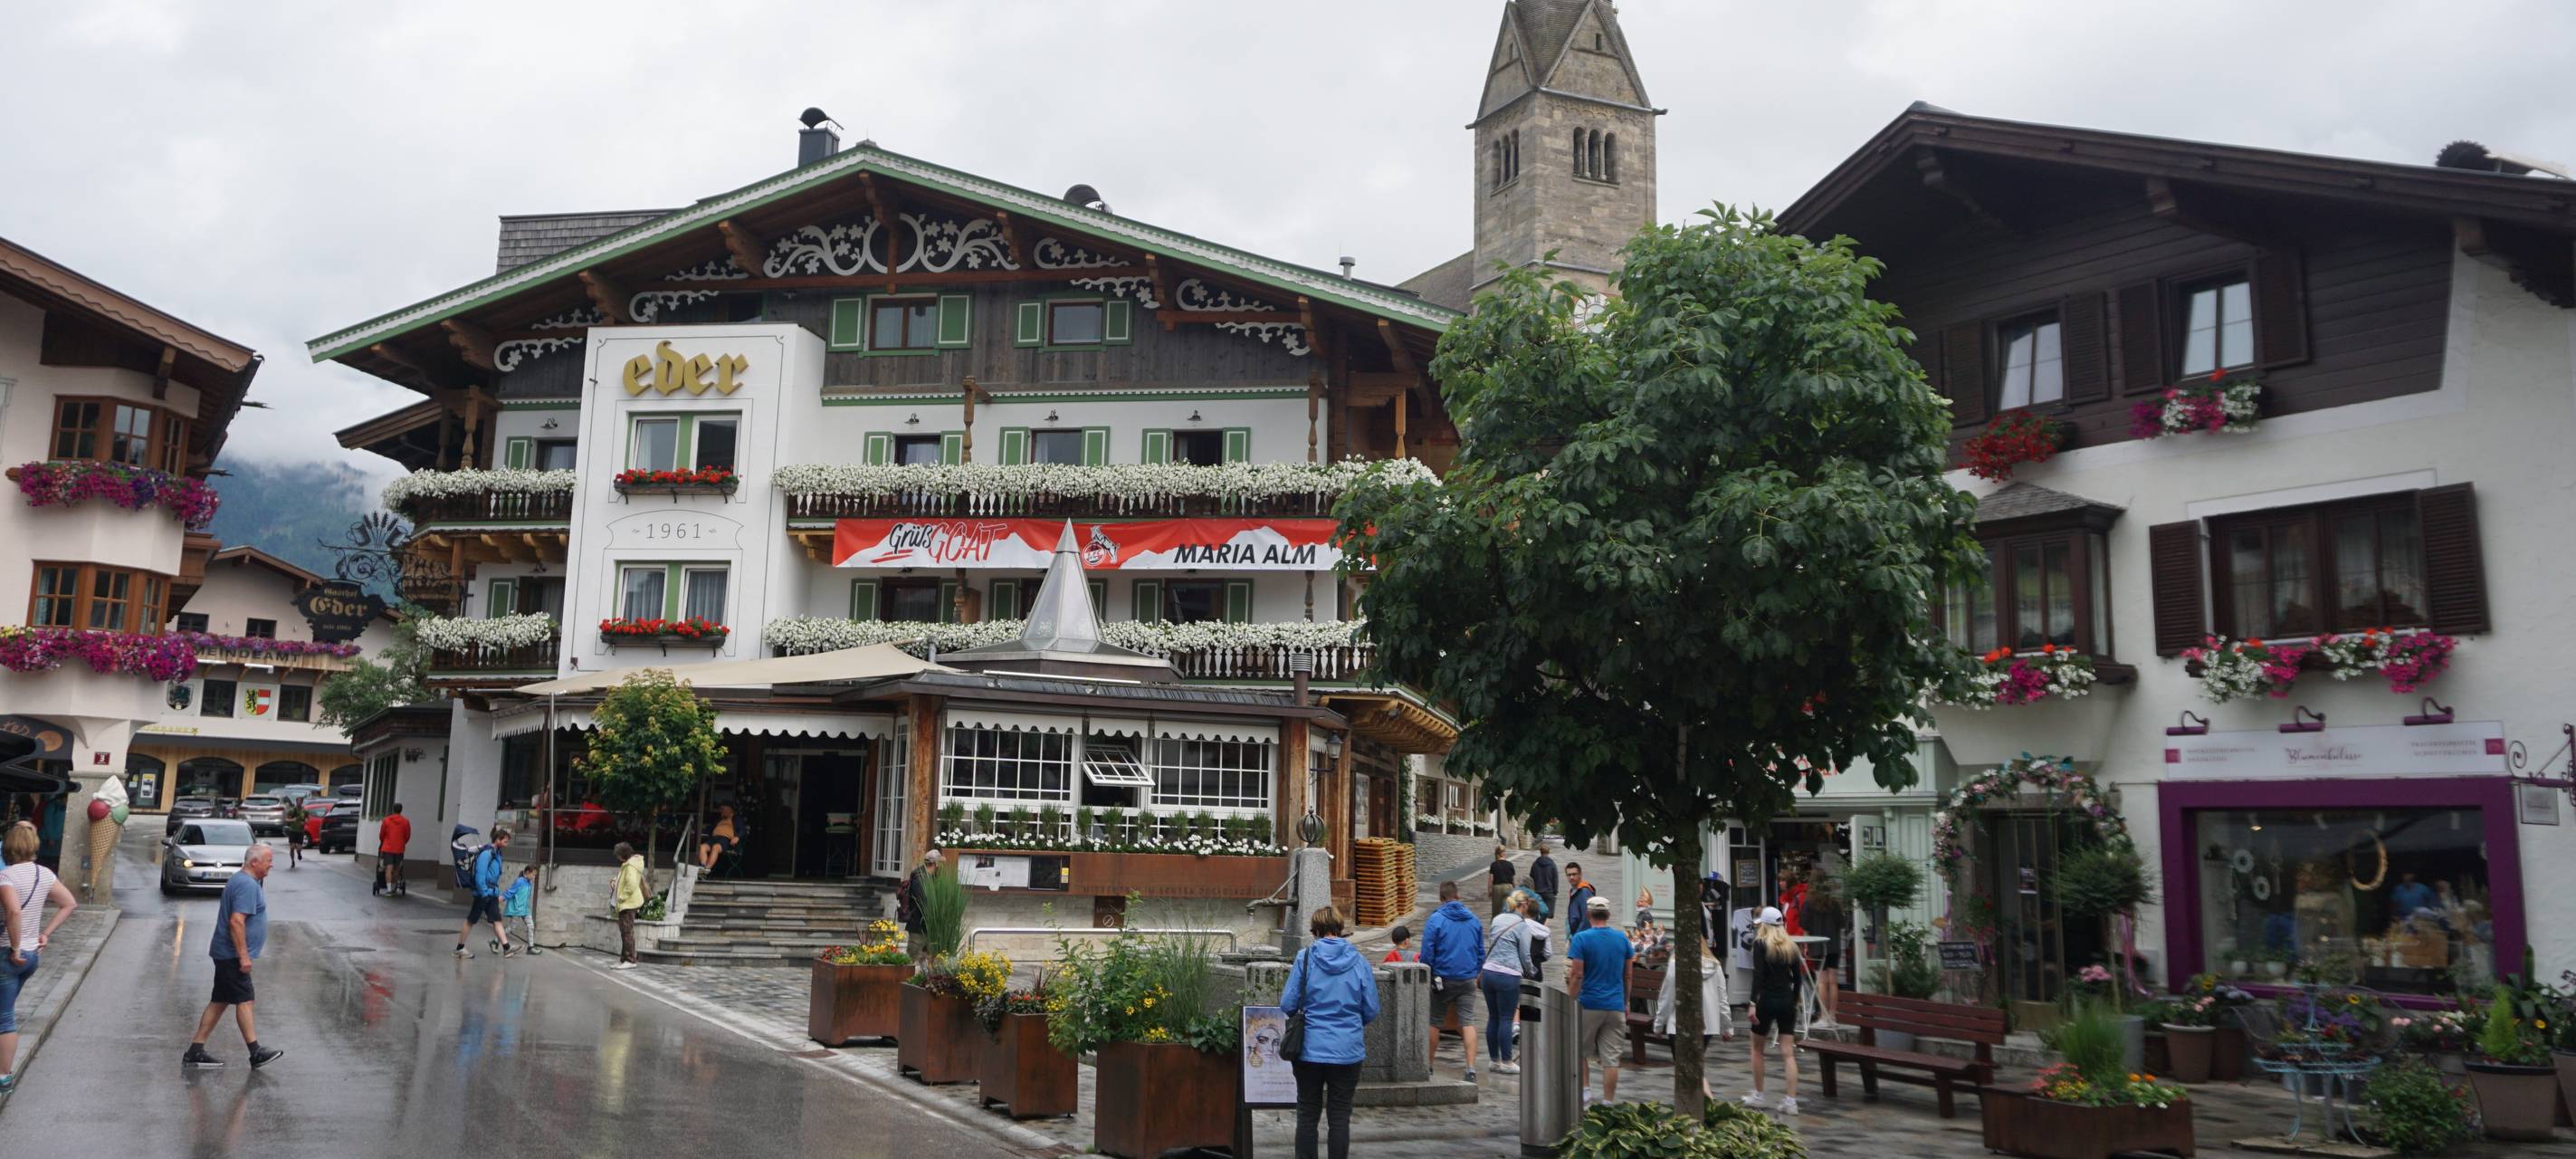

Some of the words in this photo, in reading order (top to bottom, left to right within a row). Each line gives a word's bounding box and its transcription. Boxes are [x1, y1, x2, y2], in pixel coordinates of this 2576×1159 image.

[622, 340, 749, 397] eder
[646, 522, 701, 539] 1961
[1174, 542, 1255, 565] MARIA
[1262, 542, 1316, 565] ALM
[309, 596, 368, 617] Eder
